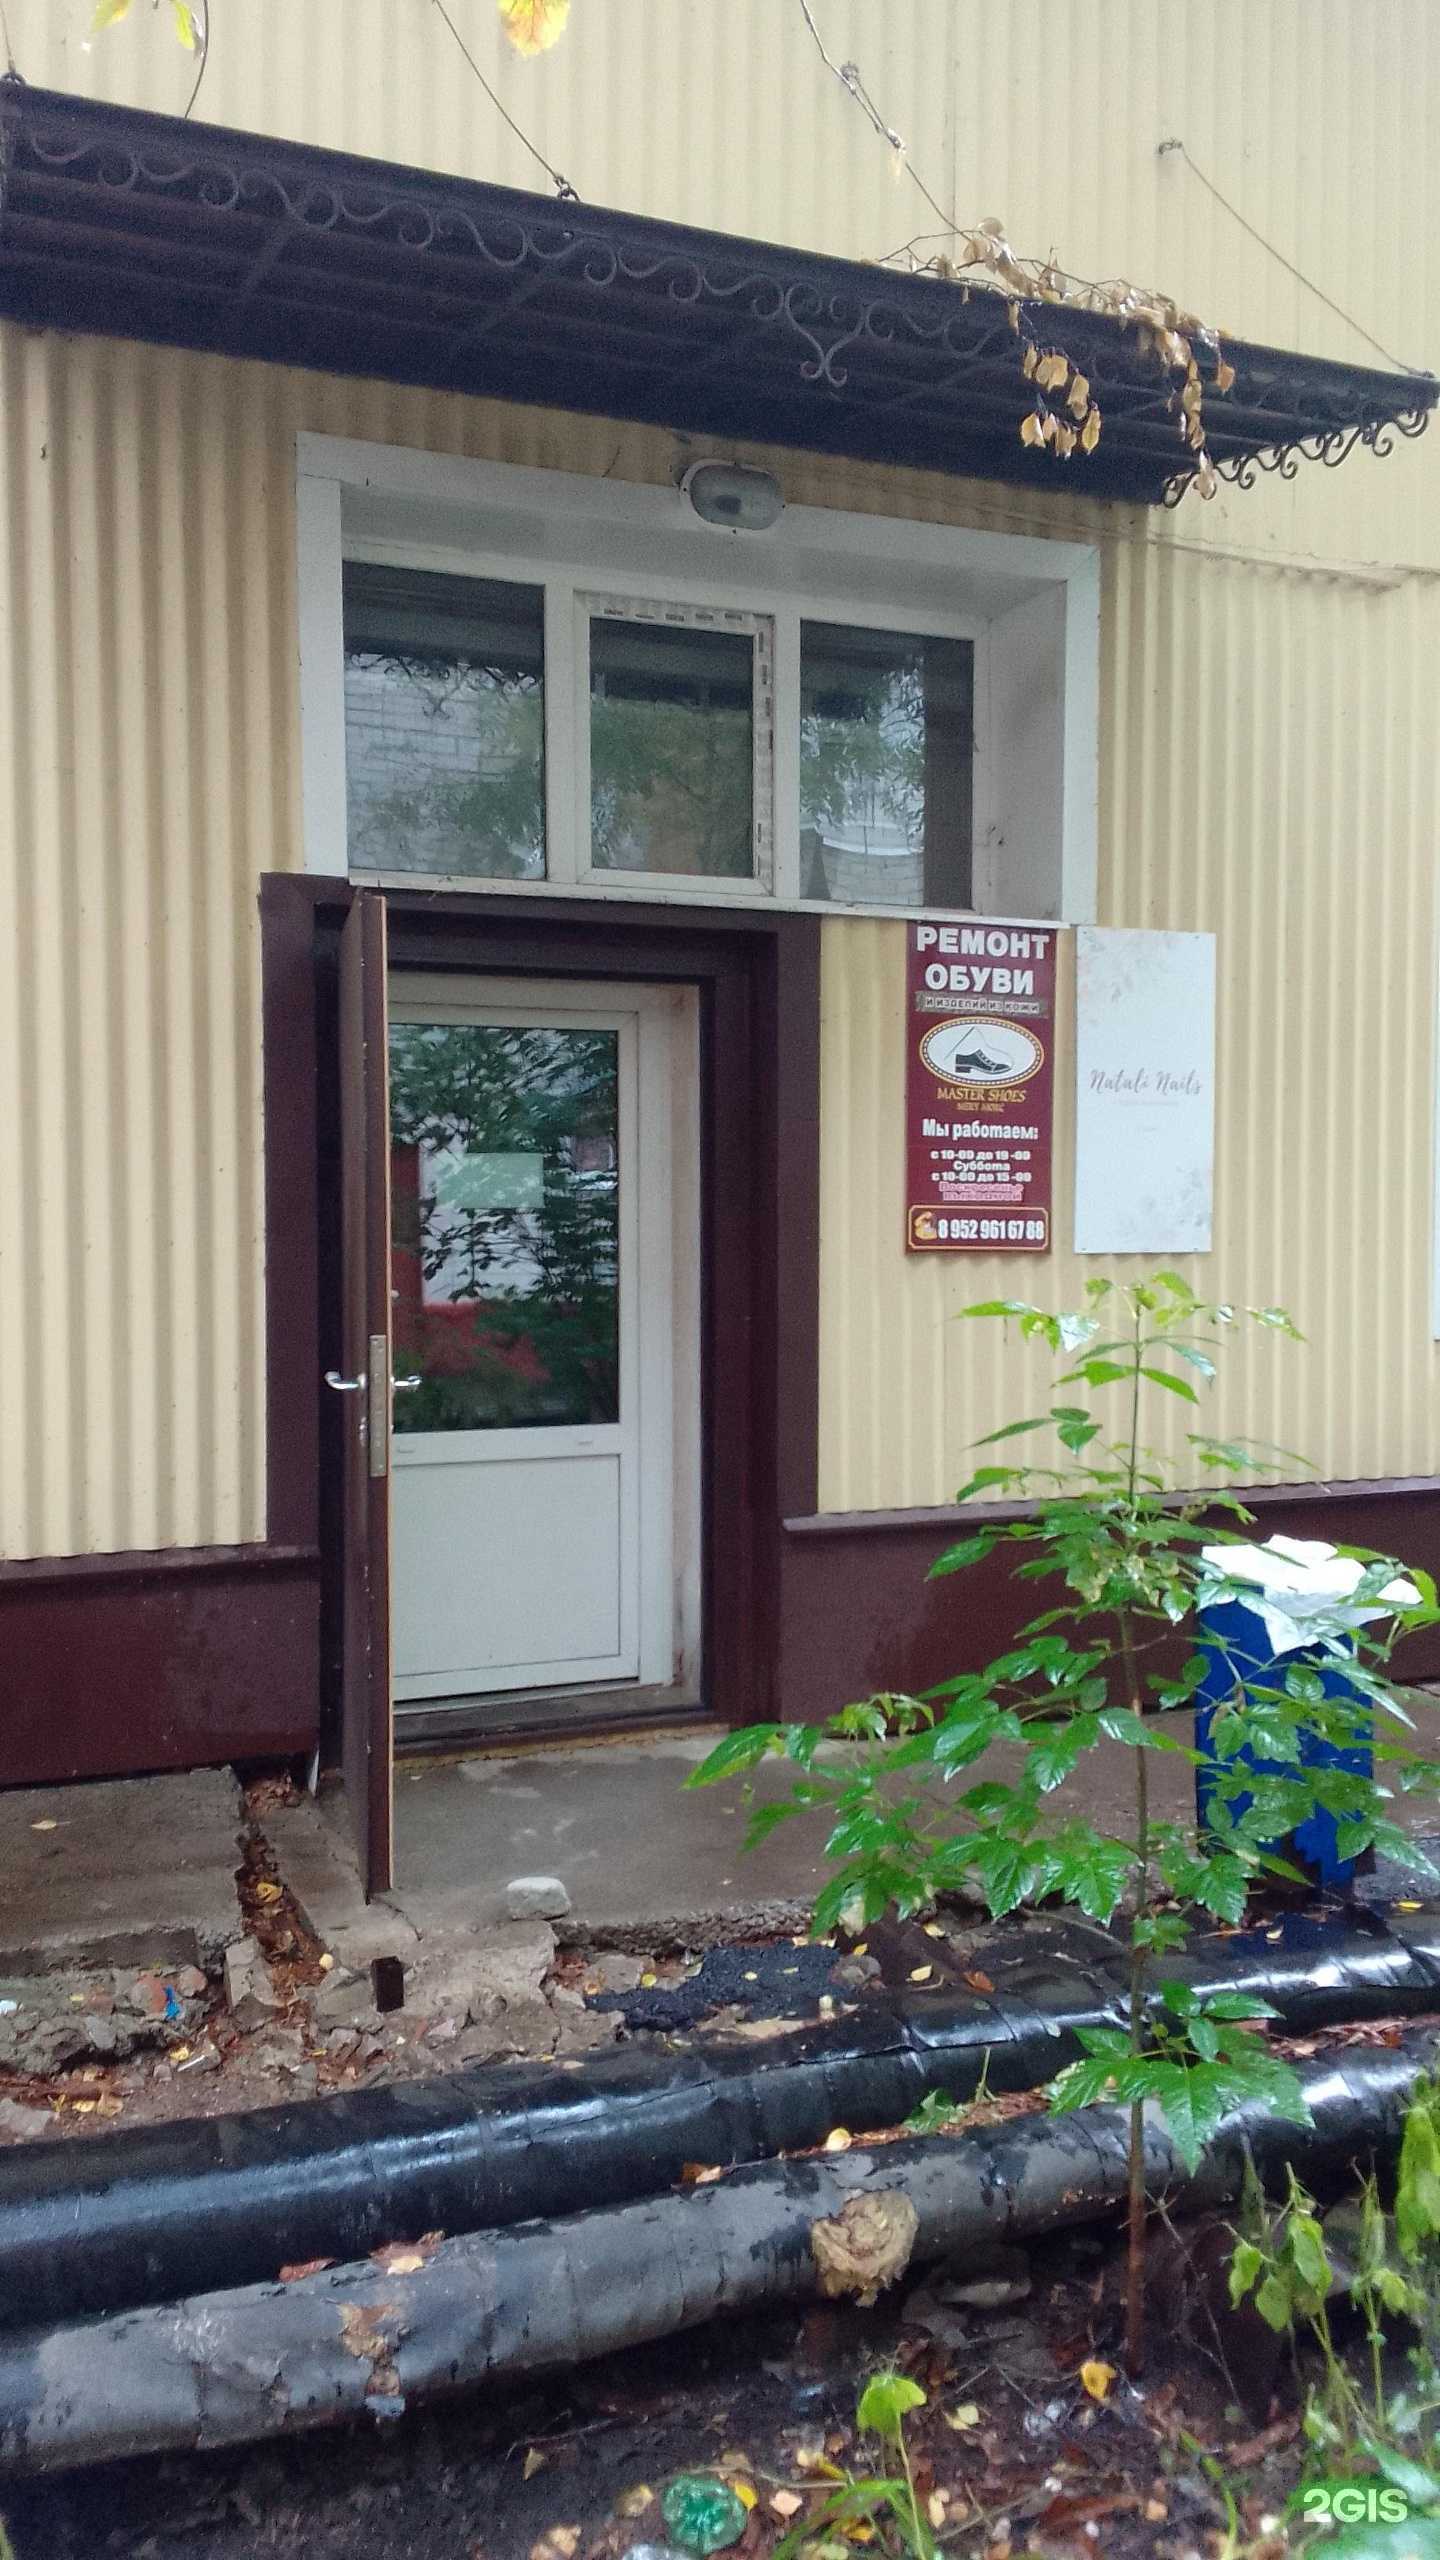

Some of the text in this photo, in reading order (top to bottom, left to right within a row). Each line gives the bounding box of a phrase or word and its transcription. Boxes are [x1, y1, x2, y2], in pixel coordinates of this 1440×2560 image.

[917, 926, 1049, 959] РЕМОНТ
[925, 963, 1034, 995] ОБУВИ
[1089, 1067, 1204, 1095] Natali Nails
[937, 1087, 1026, 1103] MASTER SHOES
[922, 1118, 1039, 1141] Мы работаем:
[953, 1160, 1010, 1172] Суббота
[976, 1151, 993, 1160] до
[938, 1218, 948, 1239] 8
[950, 1219, 978, 1239] 952
[980, 1219, 1006, 1239] 961
[1007, 1219, 1025, 1240] 67
